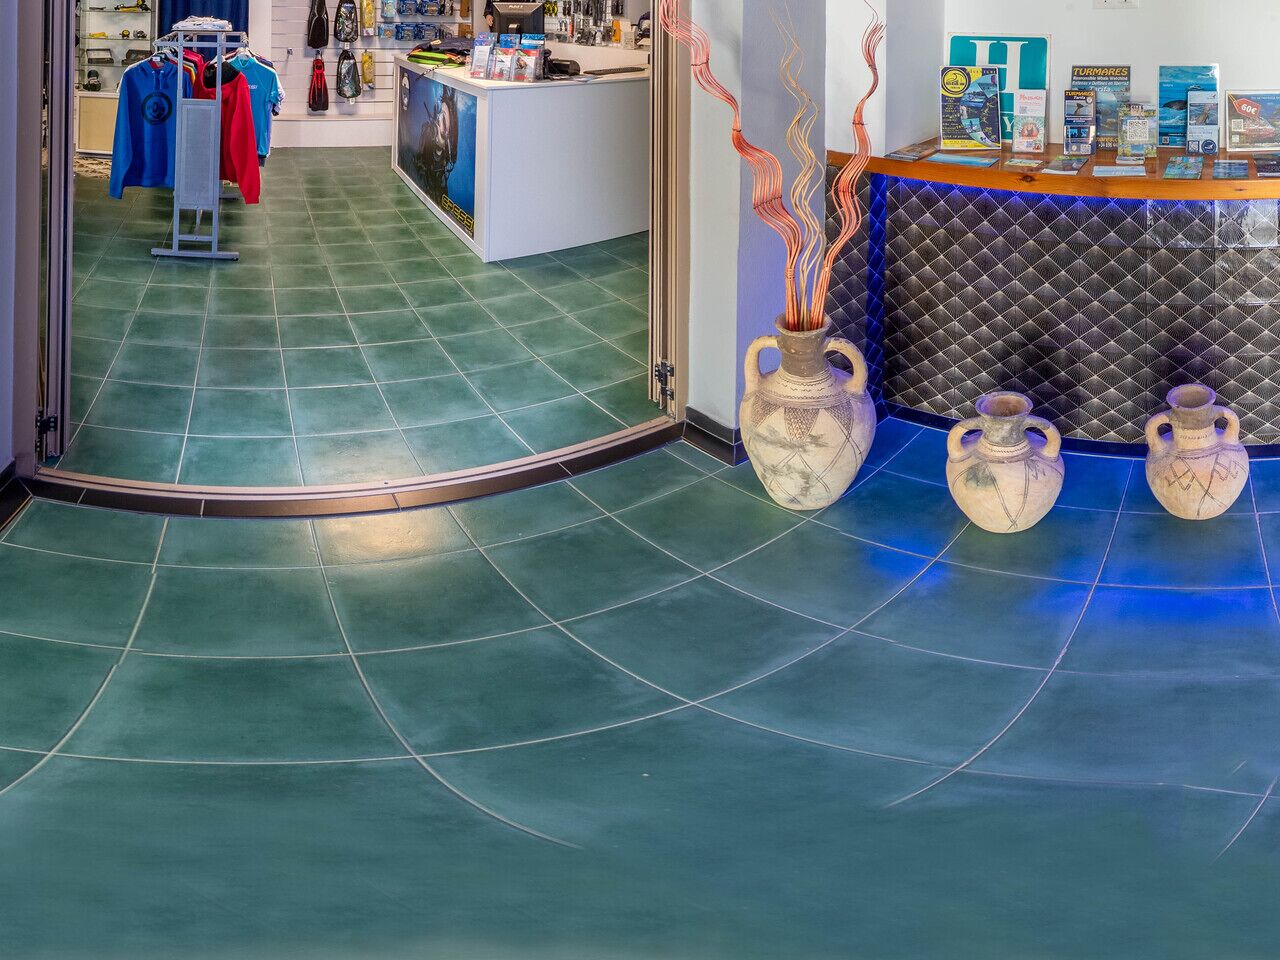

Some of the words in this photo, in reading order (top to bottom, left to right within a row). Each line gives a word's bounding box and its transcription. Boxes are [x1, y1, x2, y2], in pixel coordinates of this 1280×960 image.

[969, 40, 1028, 93] H
[1073, 67, 1129, 76] TURMARES
[1241, 103, 1257, 115] 60€
